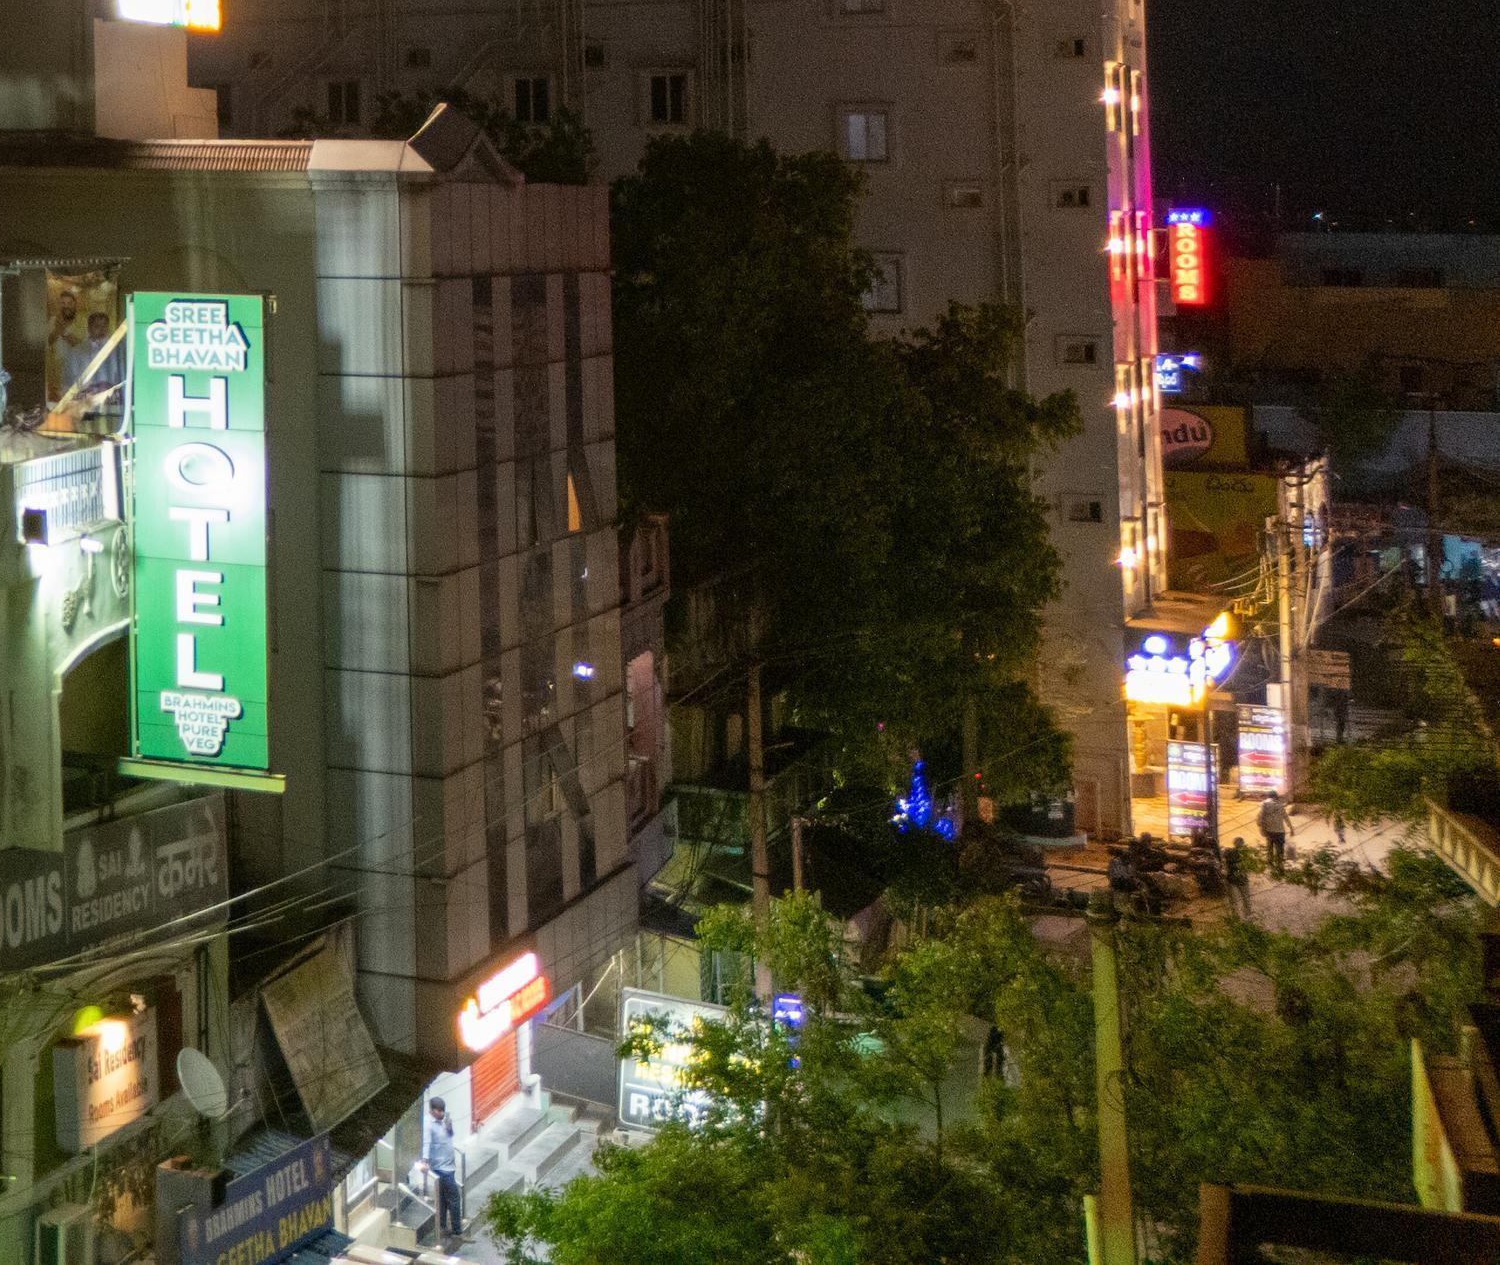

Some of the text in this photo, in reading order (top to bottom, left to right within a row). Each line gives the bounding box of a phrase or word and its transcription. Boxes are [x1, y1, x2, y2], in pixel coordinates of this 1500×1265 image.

[1175, 222, 1199, 302] ROOMS
[169, 306, 222, 324] SREE
[151, 327, 240, 346] GEETHA
[152, 348, 240, 367] BHAVAN
[166, 374, 236, 691] HOTEL
[164, 695, 237, 713] BRAHMINS
[178, 711, 222, 725] HOTEL
[182, 723, 219, 738] PURE
[187, 737, 216, 750] VEG
[71, 882, 151, 934] RESIDENCY
[265, 1158, 310, 1208] HOTEL
